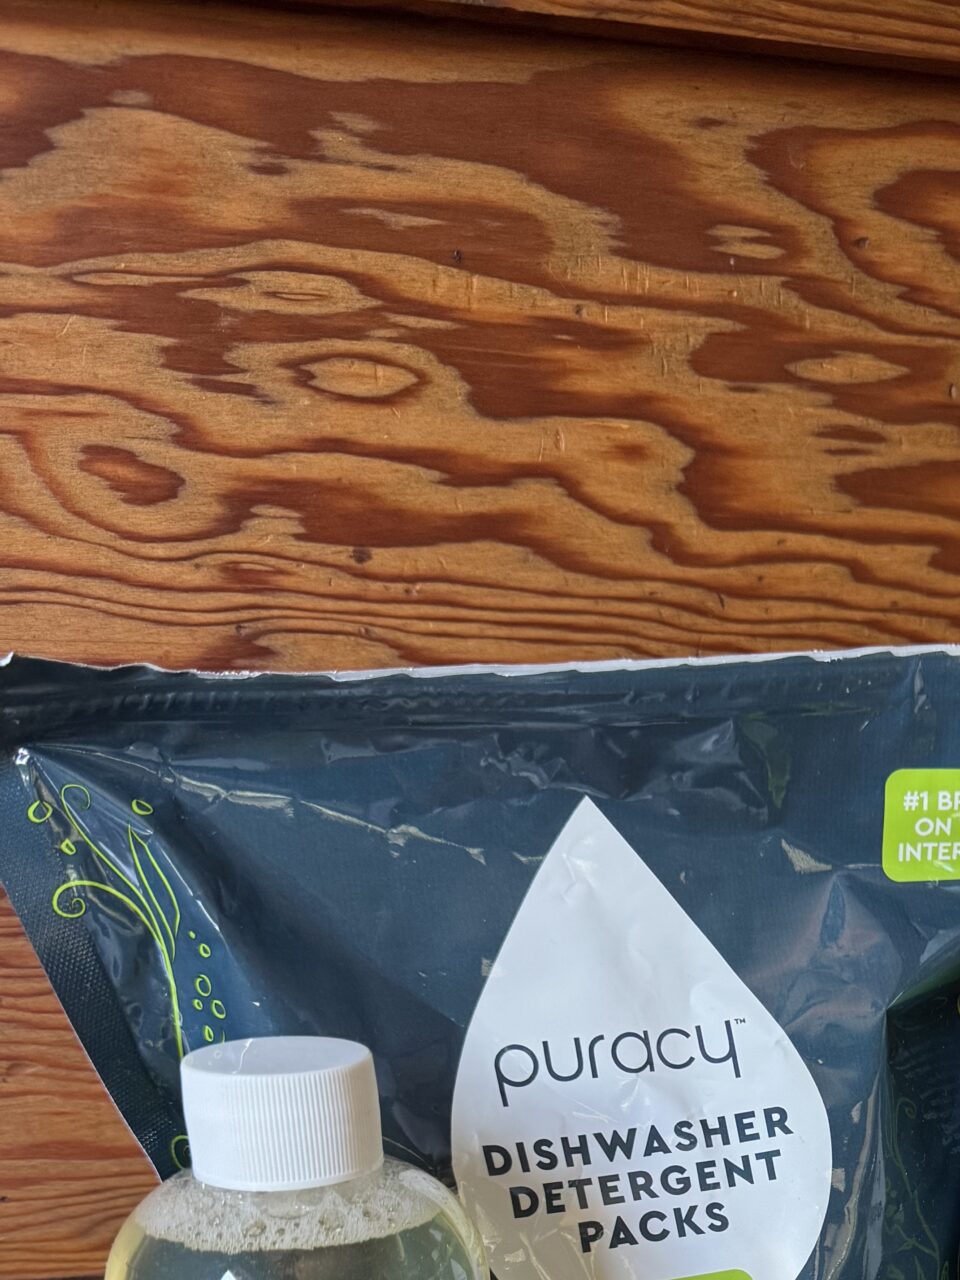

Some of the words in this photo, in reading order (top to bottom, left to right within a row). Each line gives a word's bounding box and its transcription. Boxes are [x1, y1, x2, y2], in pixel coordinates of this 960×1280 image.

[903, 791, 929, 811] #1
[914, 816, 951, 837] ON
[483, 1106, 794, 1177] DISHWASHER
[509, 1149, 782, 1219] DETERGENT
[578, 1202, 730, 1254] PACKS
